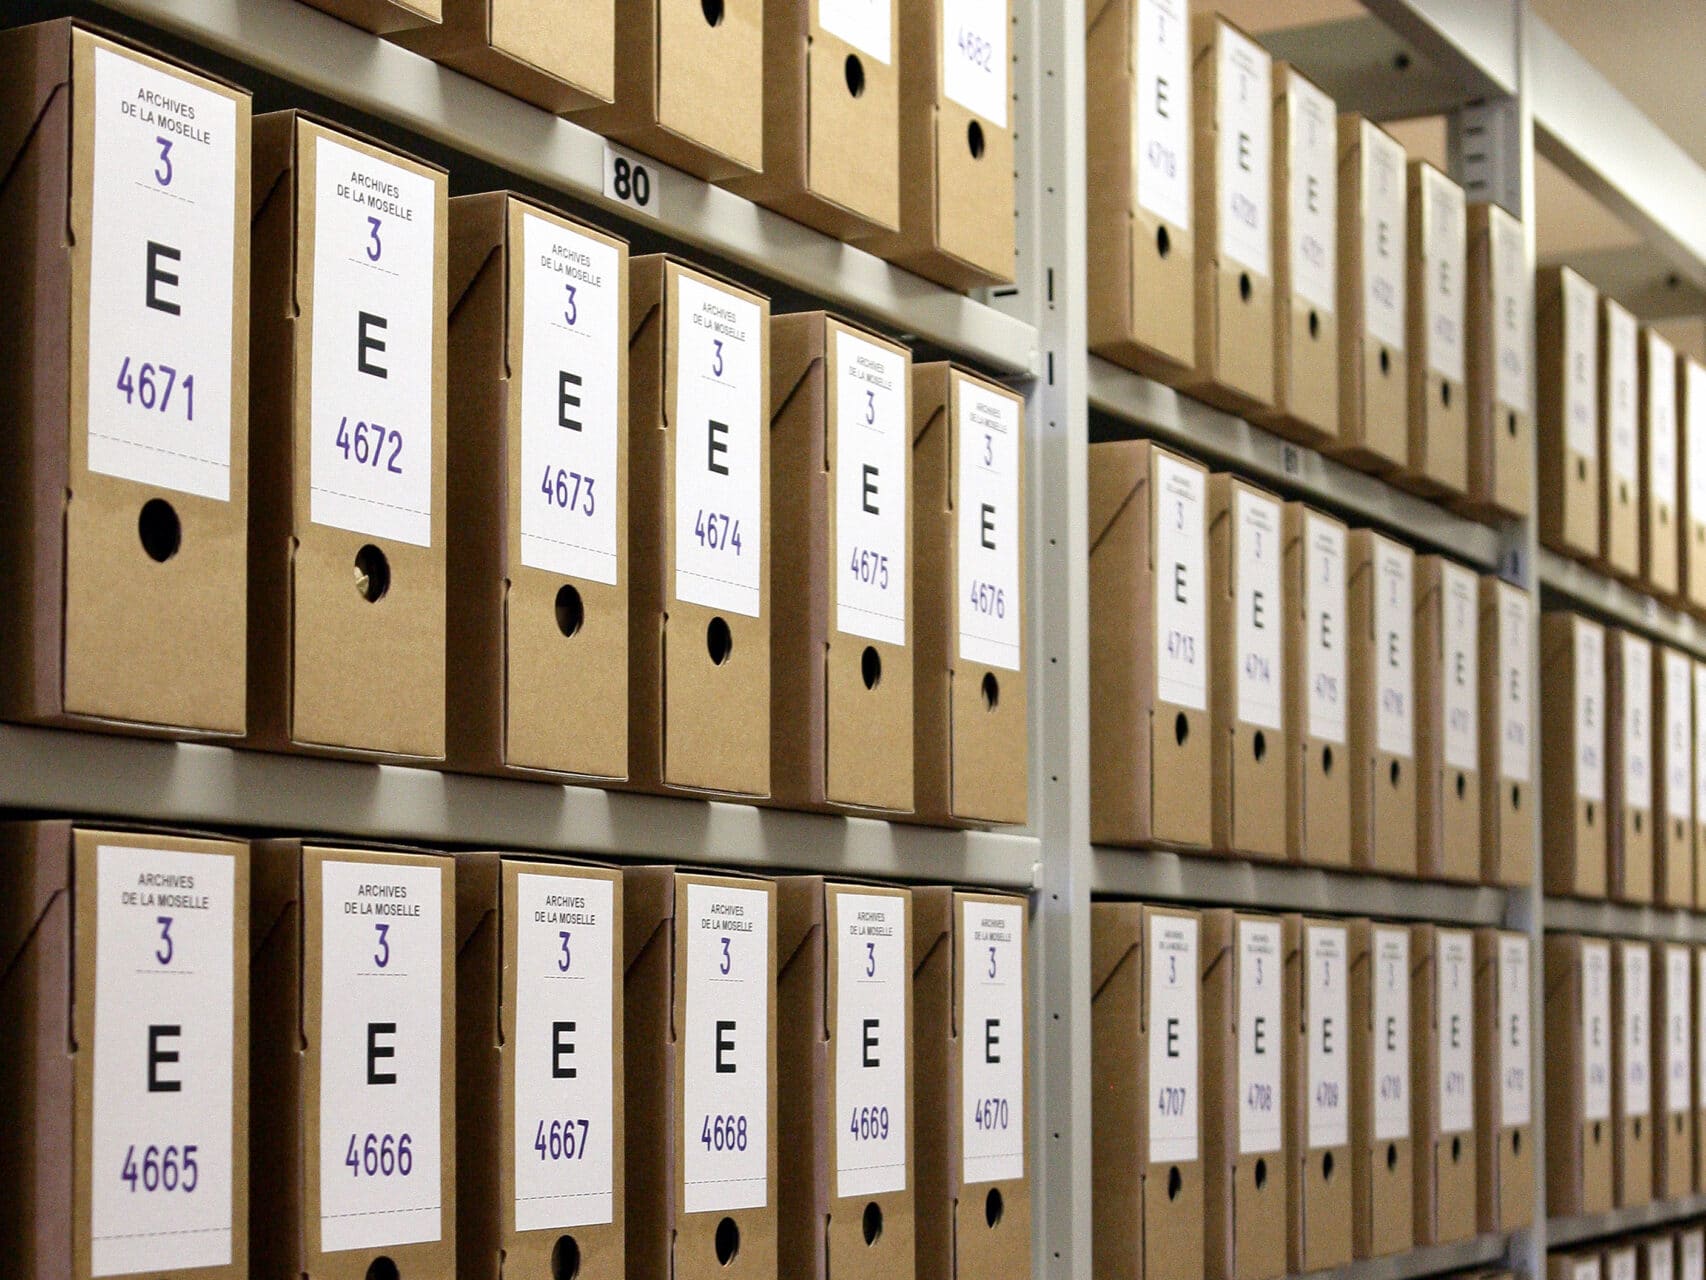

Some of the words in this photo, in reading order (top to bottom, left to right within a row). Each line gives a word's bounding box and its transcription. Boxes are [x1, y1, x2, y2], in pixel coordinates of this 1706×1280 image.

[958, 25, 992, 73] 4682
[137, 88, 195, 120] ARCHIVES
[1156, 77, 1168, 118] E
[121, 100, 136, 118] DE
[140, 108, 155, 124] LA
[157, 114, 210, 145] MOSELLE
[155, 136, 173, 186] 3
[351, 172, 399, 199] ARCHIVES
[614, 157, 650, 206] 80
[337, 184, 350, 199] DE
[353, 190, 365, 204] LA
[367, 195, 412, 221] MOSELLE
[366, 216, 382, 262] 3
[552, 244, 591, 268] ARCHIVES
[146, 241, 181, 316] E
[541, 255, 552, 269] DE
[553, 261, 563, 273] LA
[565, 265, 601, 288] MOSELLE
[564, 284, 577, 326] 3
[358, 311, 388, 379] E
[713, 339, 723, 377] 3
[117, 357, 194, 421] 4671
[558, 370, 582, 432] E
[866, 390, 875, 426] 3
[336, 417, 403, 474] 4672
[708, 420, 729, 476] E
[984, 434, 993, 467] 3
[541, 465, 595, 517] 4673
[862, 463, 880, 516] E
[695, 510, 741, 556] 4674
[980, 503, 996, 551] E
[850, 547, 888, 590] 4675
[1175, 563, 1187, 604] E
[970, 582, 1004, 619] 4676
[1253, 590, 1264, 629] E
[1167, 631, 1195, 665] 4713
[1321, 612, 1331, 649] E
[122, 891, 137, 906] DE
[140, 893, 155, 906] LA
[157, 894, 208, 910] MOSELLE
[138, 873, 194, 889] ARCHIVES
[358, 884, 407, 898] ARCHIVES
[344, 901, 358, 915] DE
[360, 903, 373, 915] LA
[375, 903, 420, 917] MOSELLE
[534, 911, 546, 923] DE
[547, 912, 558, 923] LA
[559, 913, 595, 926] MOSELLE
[546, 895, 585, 909] ARCHIVES
[711, 904, 744, 916] ARCHIVES
[156, 916, 173, 965] 3
[701, 918, 711, 929] DE
[712, 919, 721, 930] LA
[722, 920, 753, 932] MOSELLE
[374, 923, 389, 968] 3
[558, 931, 571, 972] 3
[720, 937, 731, 975] 3
[866, 942, 875, 976] 3
[988, 946, 997, 979] 3
[552, 1021, 577, 1079] E
[715, 1020, 736, 1073] E
[863, 1019, 880, 1068] E
[985, 1018, 1001, 1064] E
[1167, 1018, 1180, 1058] E
[1254, 1017, 1266, 1055] E
[1322, 1018, 1333, 1054] E
[1386, 1016, 1396, 1051] E
[1450, 1015, 1460, 1049] E
[148, 1025, 181, 1093] E
[367, 1022, 397, 1085] E
[974, 1097, 1009, 1130] 4670
[1158, 1087, 1186, 1115] 4707
[535, 1119, 589, 1160] 4667
[701, 1115, 747, 1151] 4668
[850, 1106, 889, 1140] 4669
[122, 1145, 198, 1193] 4665
[345, 1133, 412, 1177] 4666
